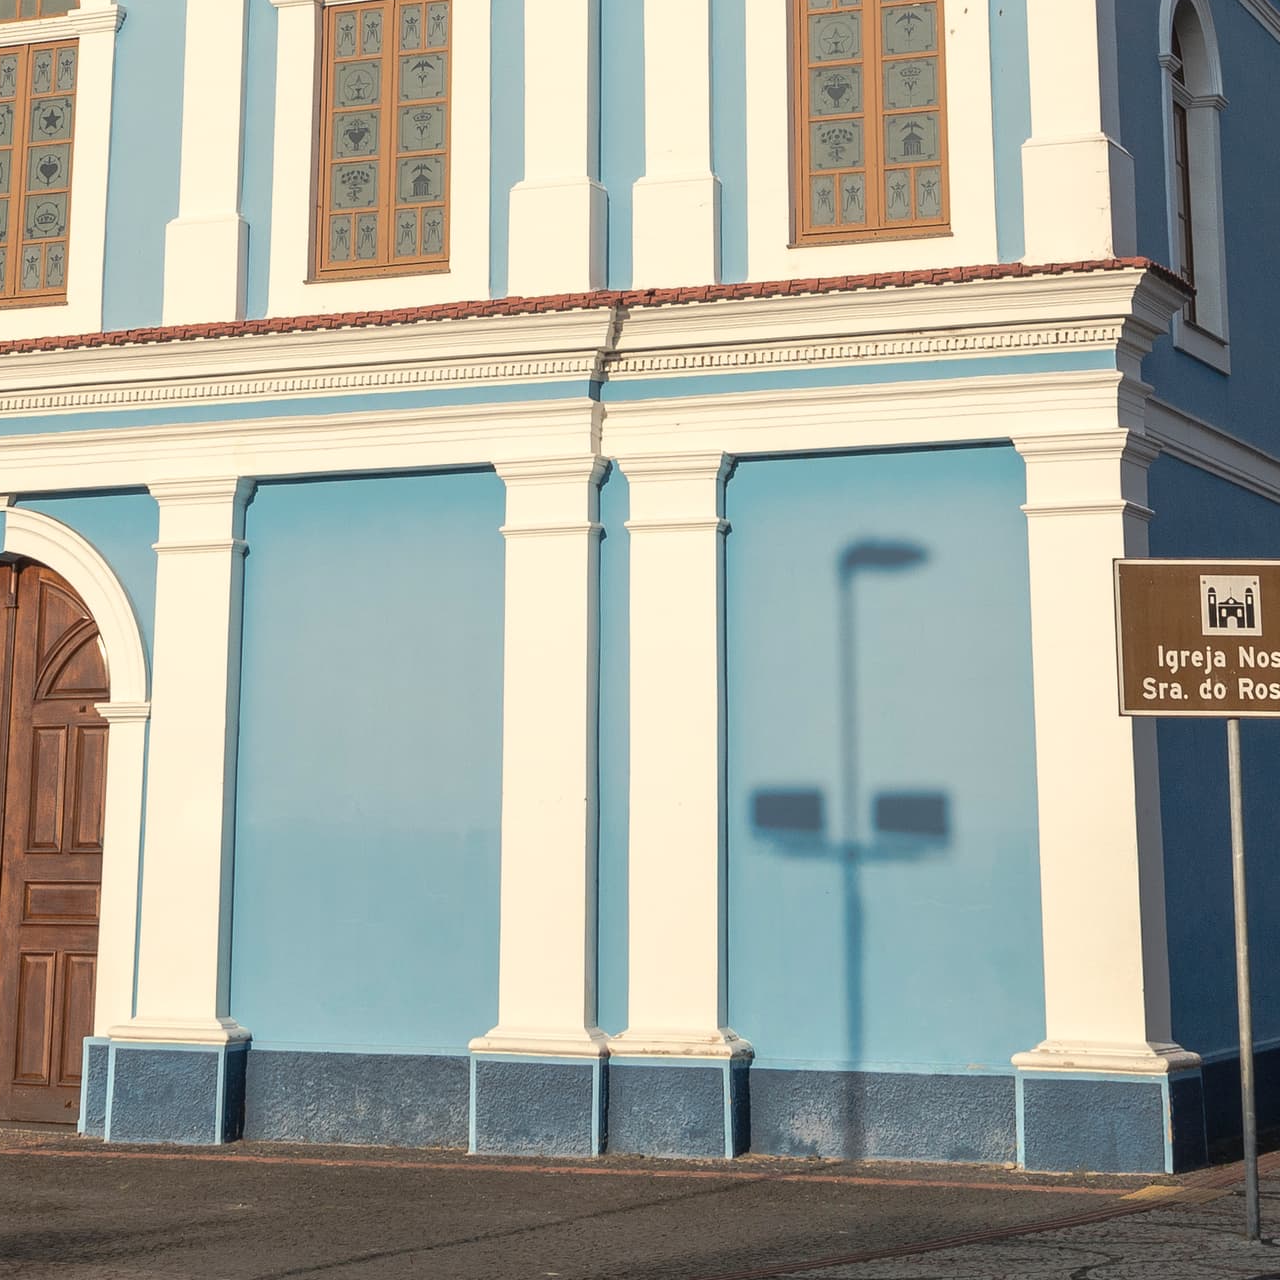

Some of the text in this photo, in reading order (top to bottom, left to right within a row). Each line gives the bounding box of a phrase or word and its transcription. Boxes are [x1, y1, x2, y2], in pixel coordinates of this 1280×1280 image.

[1157, 645, 1226, 674] Igreja
[1142, 677, 1189, 700] Sra.
[1199, 678, 1227, 700] do
